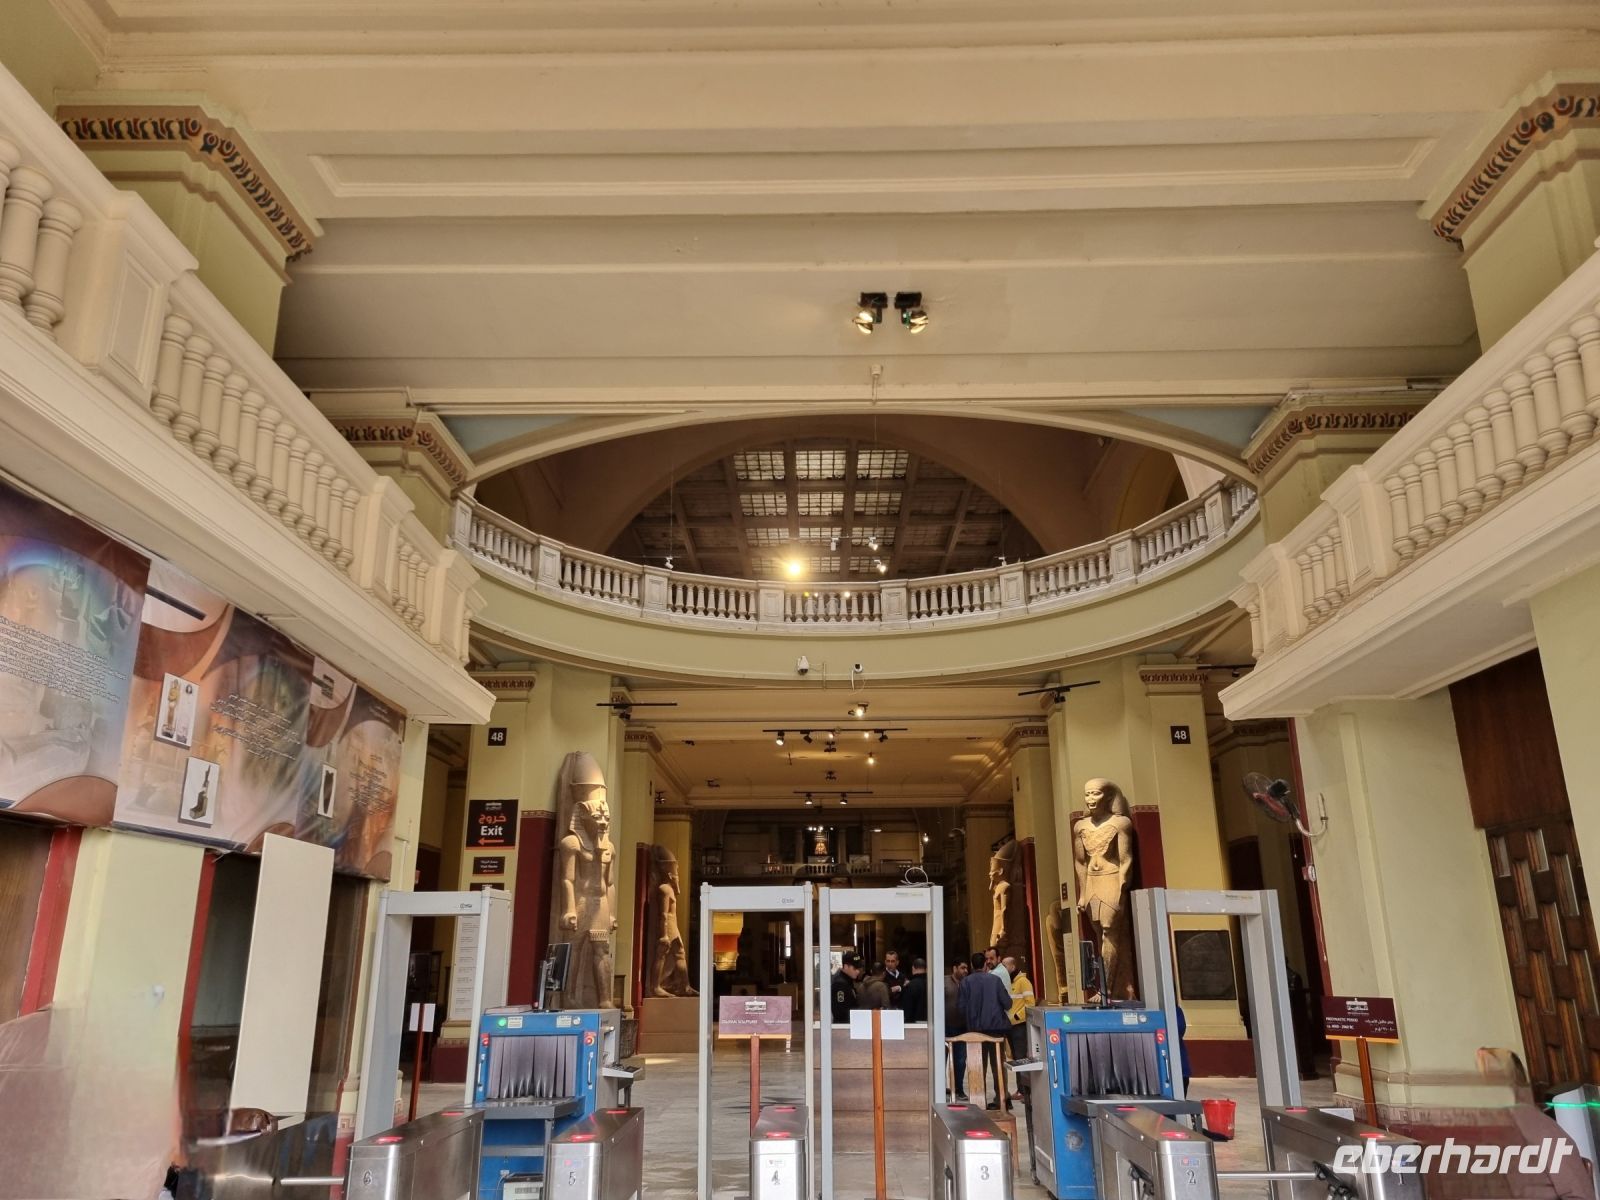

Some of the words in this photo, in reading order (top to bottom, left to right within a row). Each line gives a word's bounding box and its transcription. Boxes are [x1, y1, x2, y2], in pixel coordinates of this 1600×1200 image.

[491, 732, 504, 741] 48
[1174, 730, 1187, 740] 48
[478, 813, 507, 824] خروج
[480, 825, 503, 836] Exit
[363, 1169, 373, 1186] 6
[567, 1171, 577, 1186] 5
[771, 1169, 781, 1186] 4
[980, 1165, 990, 1181] 3
[1185, 1168, 1197, 1186] 2
